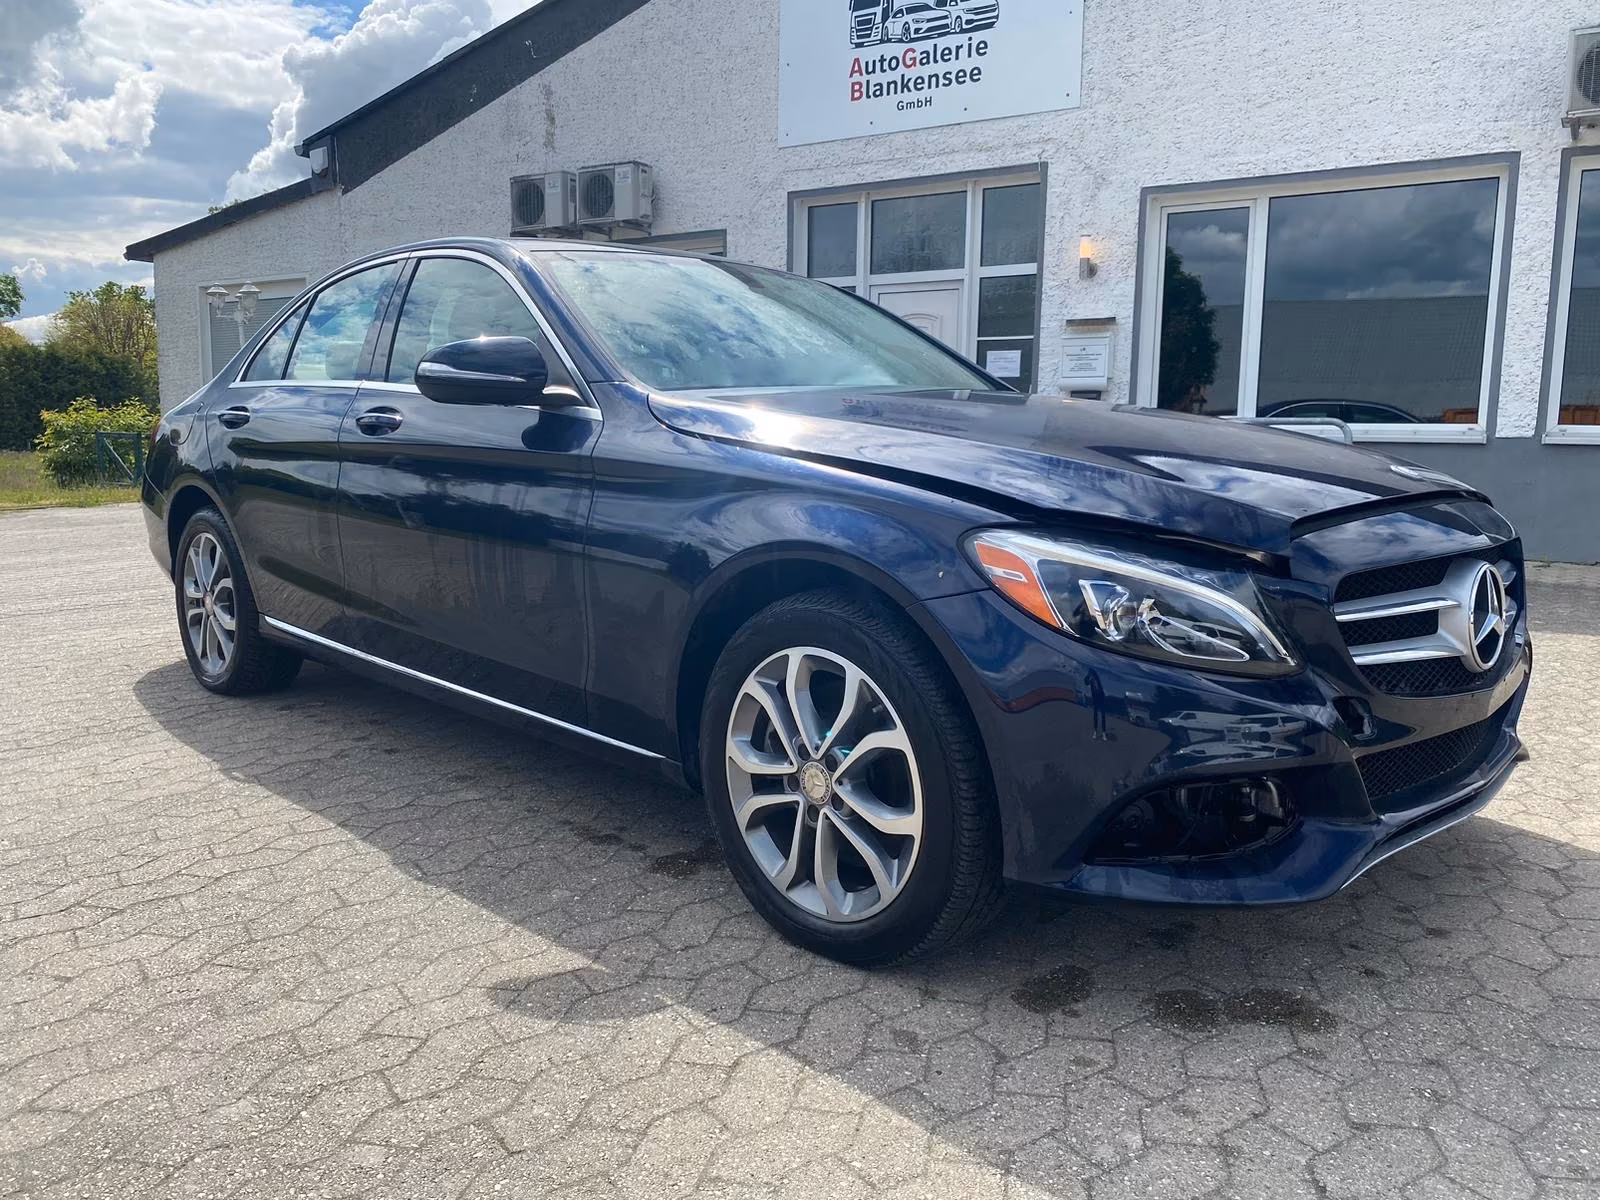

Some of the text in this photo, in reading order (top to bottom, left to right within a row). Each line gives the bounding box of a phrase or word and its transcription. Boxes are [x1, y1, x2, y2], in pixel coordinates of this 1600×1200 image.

[850, 36, 989, 78] AutoGalerie
[850, 66, 982, 102] Blankensee
[896, 96, 933, 112] GmbH
